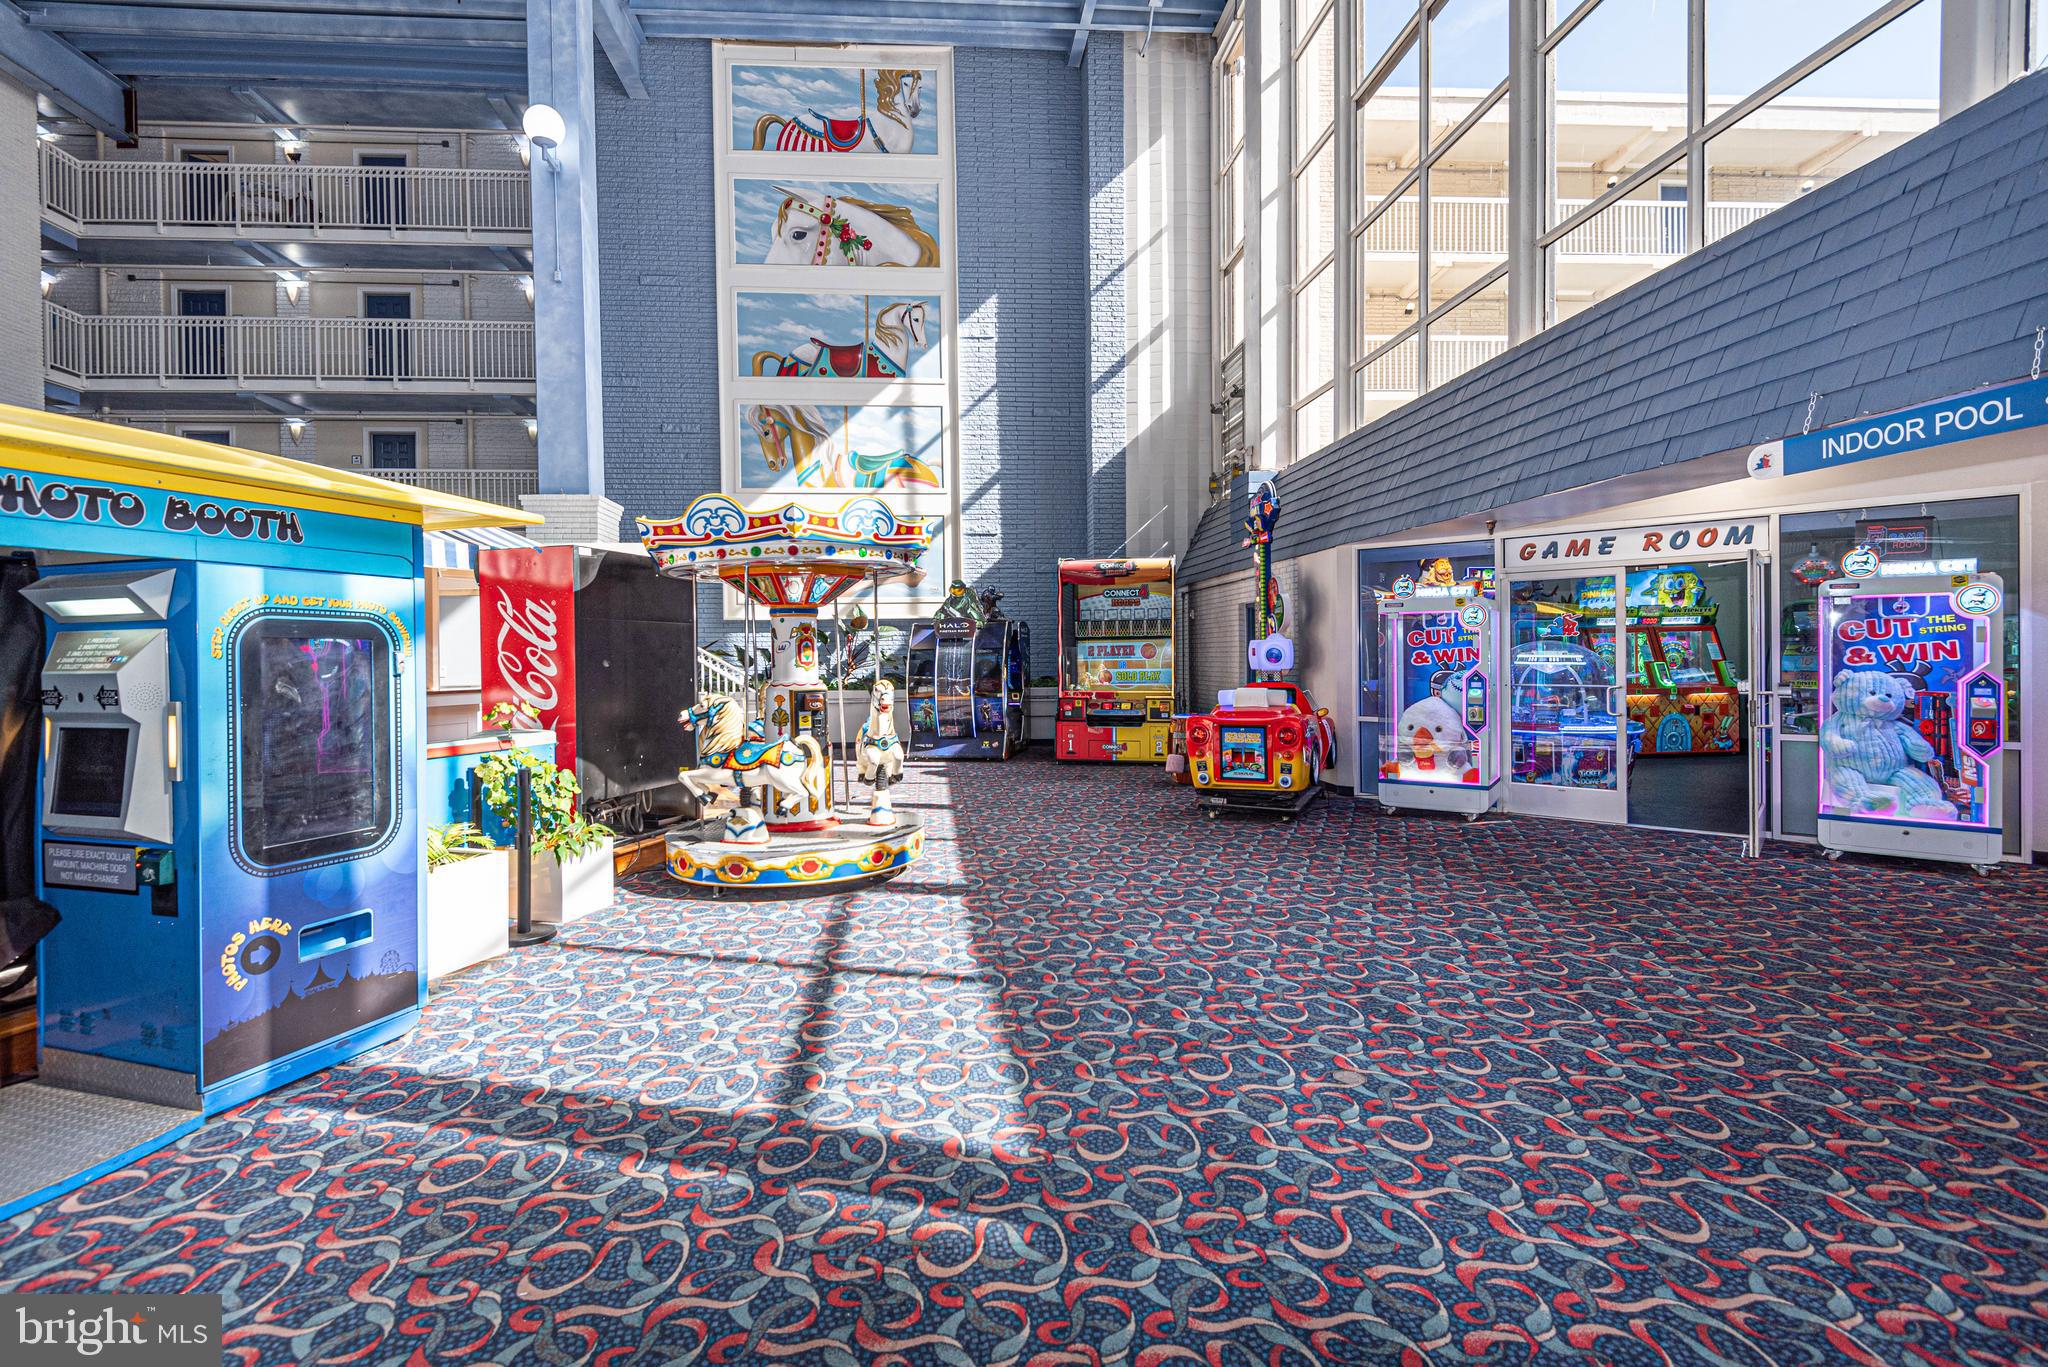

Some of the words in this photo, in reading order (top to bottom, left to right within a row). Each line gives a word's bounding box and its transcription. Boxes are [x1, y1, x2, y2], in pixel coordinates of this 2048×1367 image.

[1821, 417, 1926, 459] INDOOR
[1934, 396, 2024, 436] POOL
[0, 473, 146, 527] HOTO
[162, 495, 305, 544] BOOTH
[1519, 535, 1617, 561] GAME
[1642, 524, 1756, 553] ROOM
[1104, 589, 1140, 597] CONNECT
[1139, 585, 1149, 598] 4
[211, 627, 225, 659] STEP
[254, 594, 270, 605] UP
[273, 595, 299, 606] AND
[302, 597, 326, 606] GET
[327, 599, 353, 608] YOUR
[1838, 617, 1917, 642] CUT
[1926, 614, 1956, 624] THE
[1919, 624, 1967, 635] STRING
[1407, 627, 1457, 647] CUT
[1096, 645, 1135, 657] PLAYER
[1411, 651, 1432, 666] &
[1432, 647, 1480, 664] WIN
[1844, 646, 1877, 666] &
[1878, 640, 1961, 664] WIN
[1116, 671, 1137, 681] SOLO
[1138, 671, 1161, 681] PLAY
[100, 690, 116, 698] LOOK
[48, 847, 72, 858] PLEASE
[71, 849, 85, 859] USE
[85, 850, 106, 860] EXACT
[106, 851, 132, 862] DOLLAR
[80, 861, 109, 872] MACHINE
[109, 863, 127, 874] DOES
[60, 871, 75, 880] NOT
[74, 872, 93, 882] MAKE
[93, 874, 120, 885] CHANGE
[220, 931, 249, 992] PHOTOS
[248, 916, 293, 936] HERE
